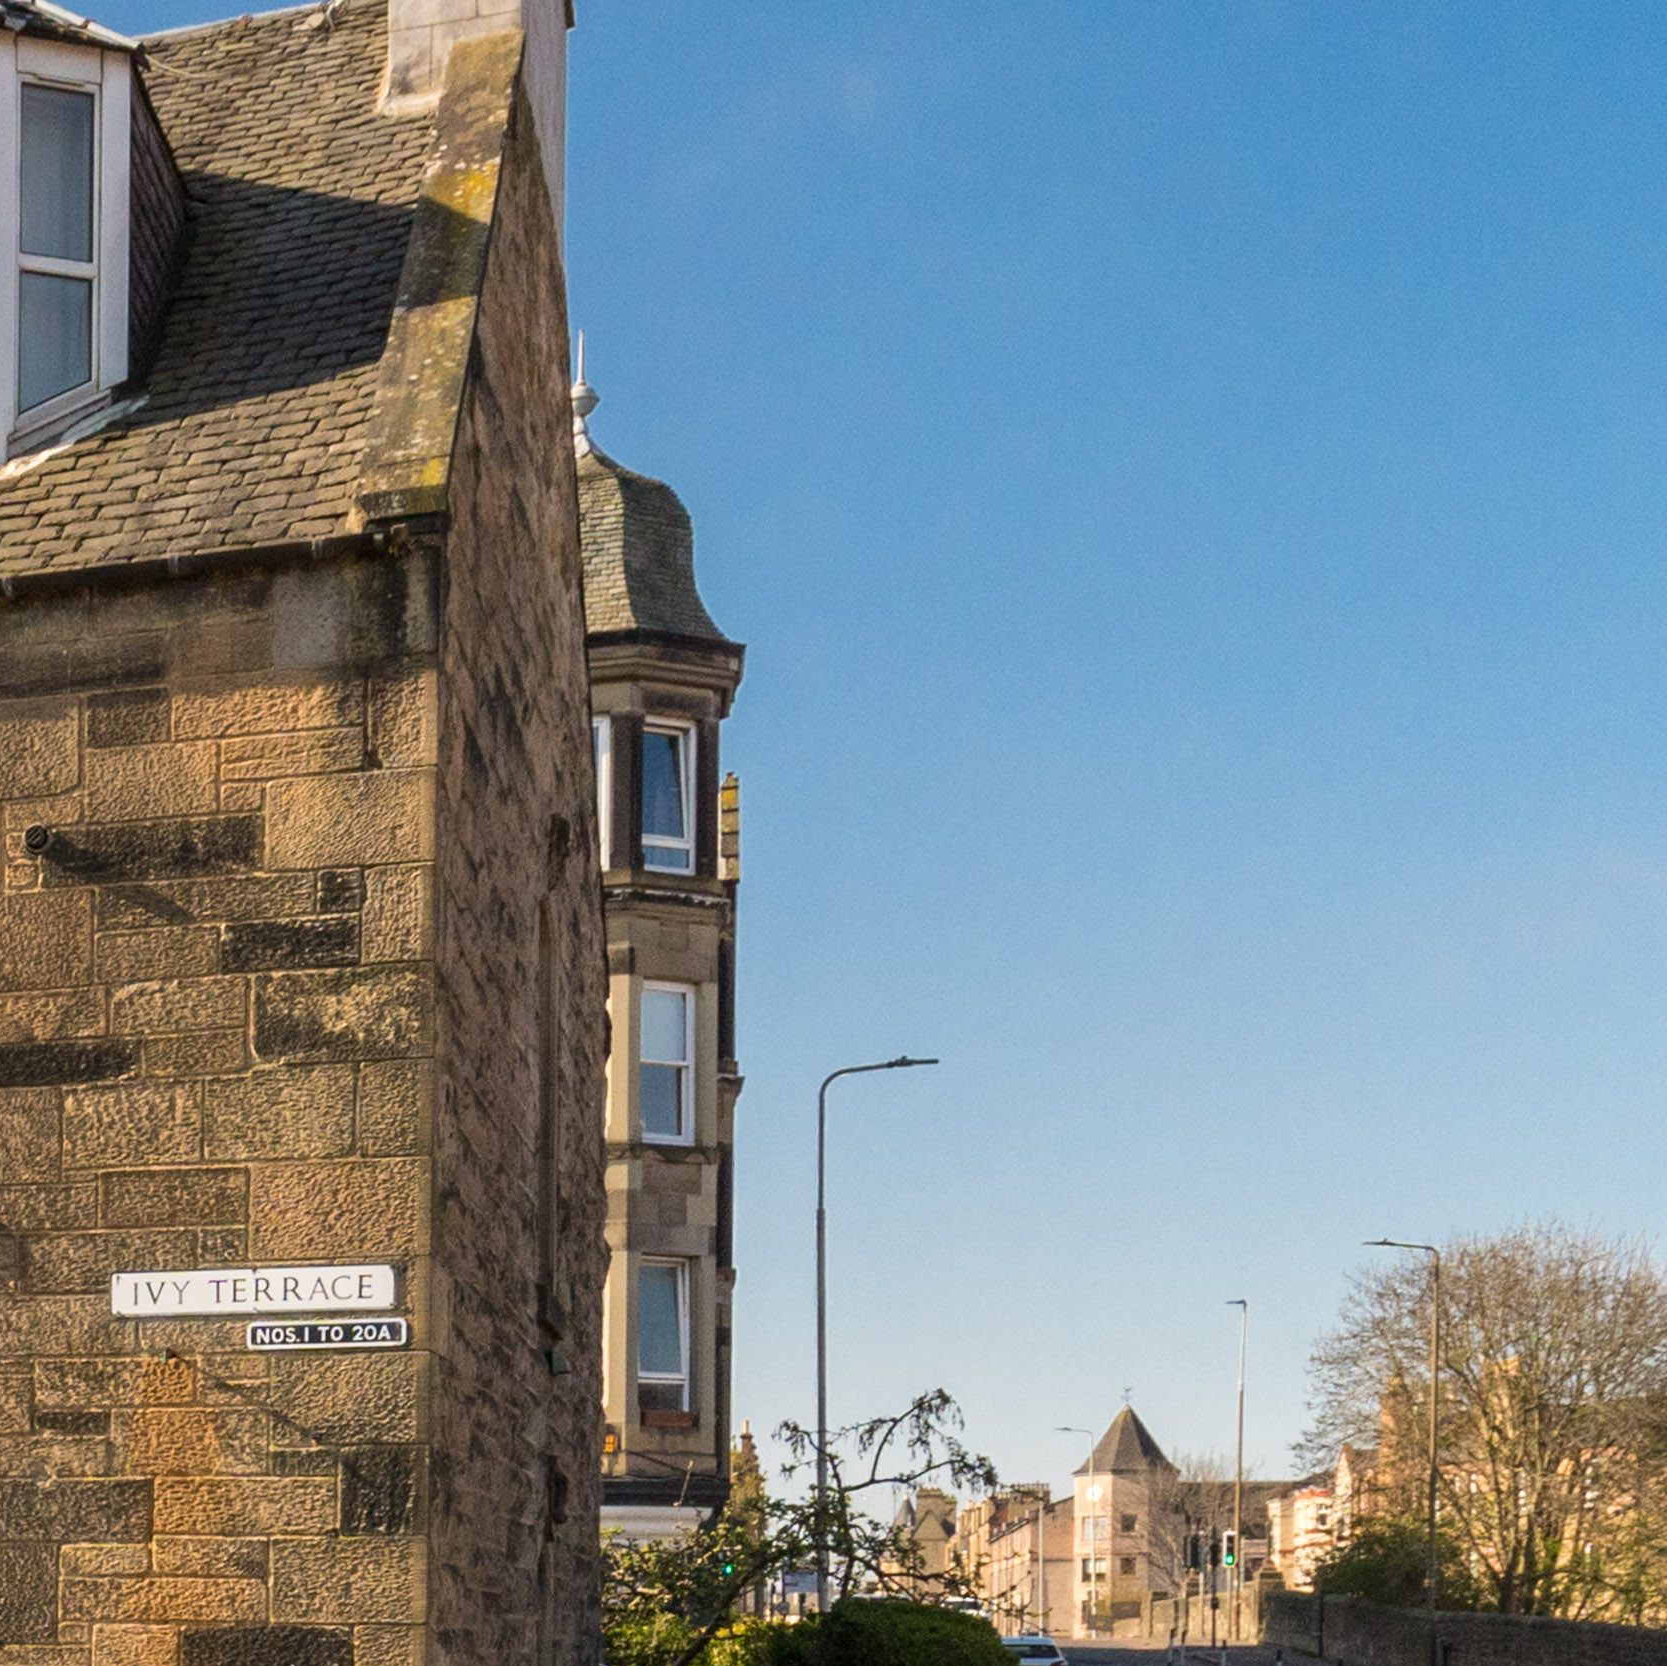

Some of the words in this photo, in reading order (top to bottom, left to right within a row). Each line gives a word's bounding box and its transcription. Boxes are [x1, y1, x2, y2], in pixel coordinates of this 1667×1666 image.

[132, 1280, 190, 1306] IVY
[208, 1274, 374, 1304] TERRACE
[317, 1326, 344, 1342] TO
[352, 1324, 391, 1341] 20A
